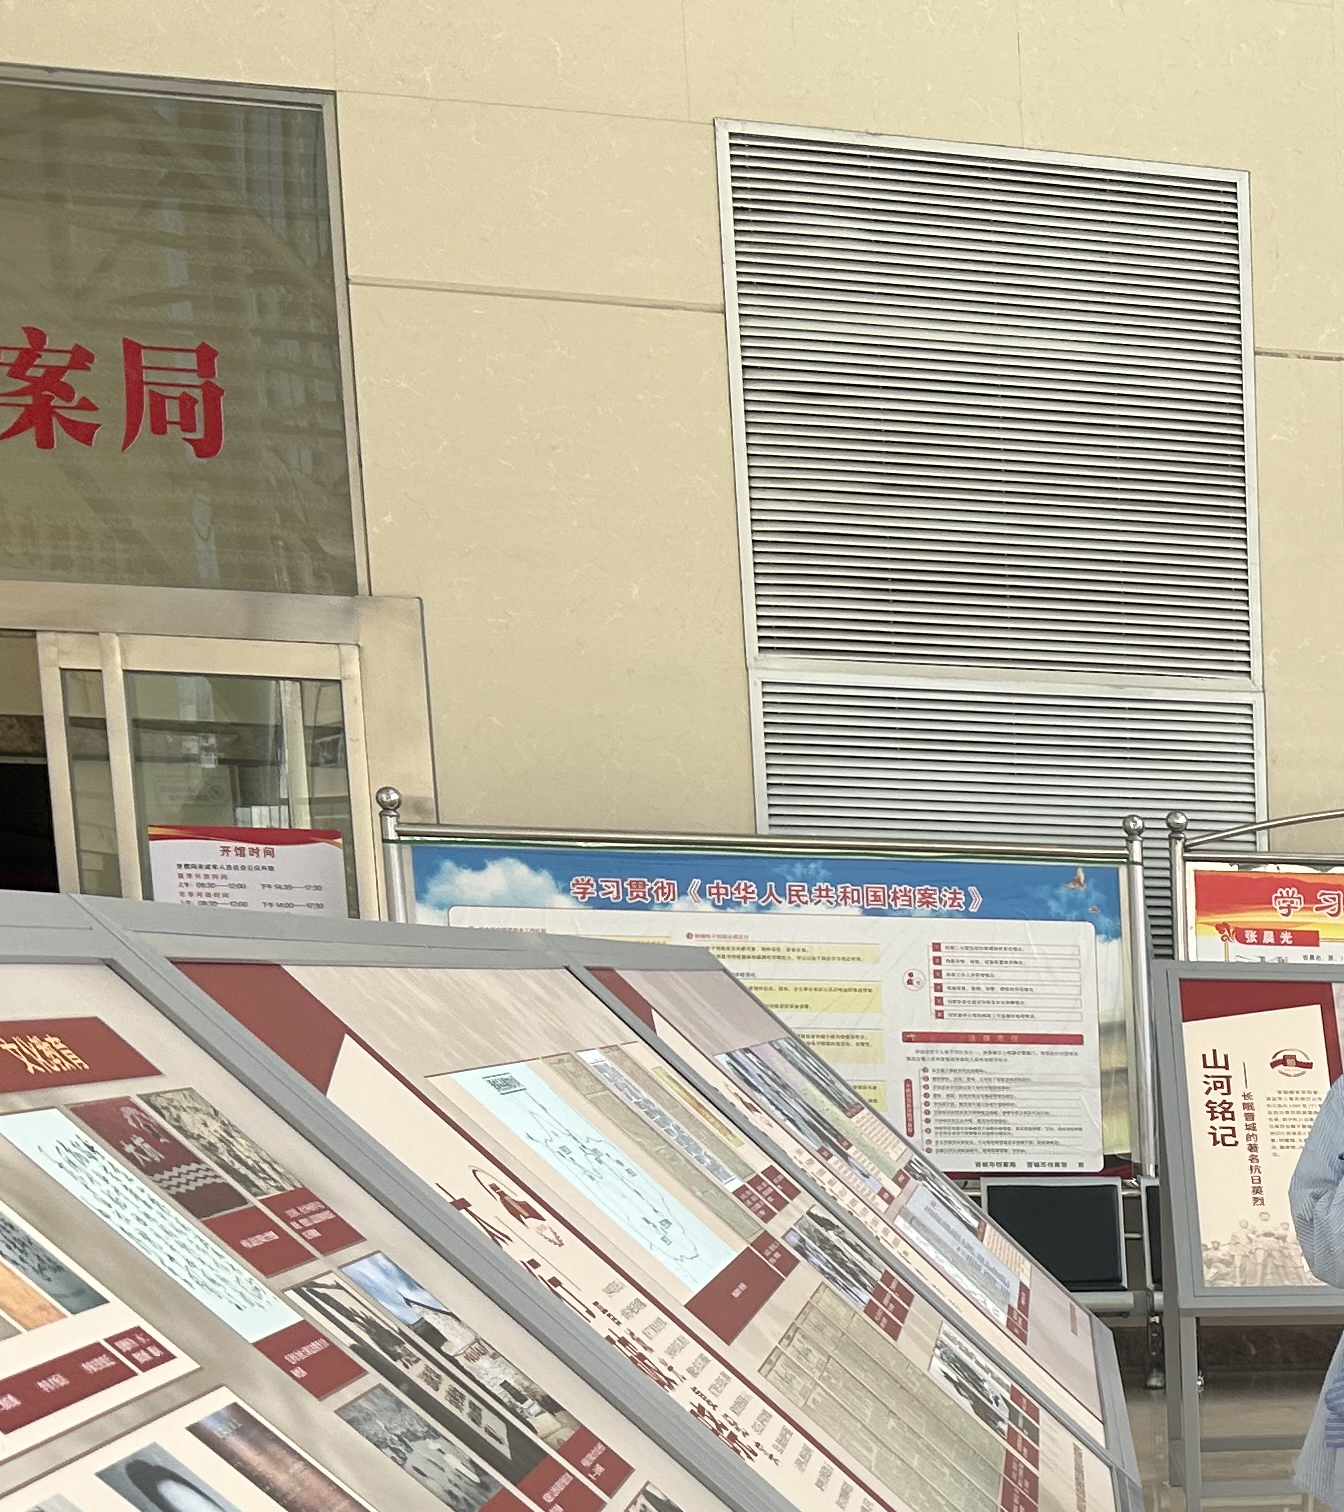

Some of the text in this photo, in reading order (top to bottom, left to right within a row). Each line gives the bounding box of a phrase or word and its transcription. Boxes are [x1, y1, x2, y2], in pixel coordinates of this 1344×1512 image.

[0, 325, 226, 459] 案局
[219, 845, 276, 858] 开馆时间
[570, 876, 984, 914] 学习贯彻《中华人民共和国档案法》
[1244, 929, 1294, 945] 张晨光
[1201, 1048, 1239, 1148] 山河铭记
